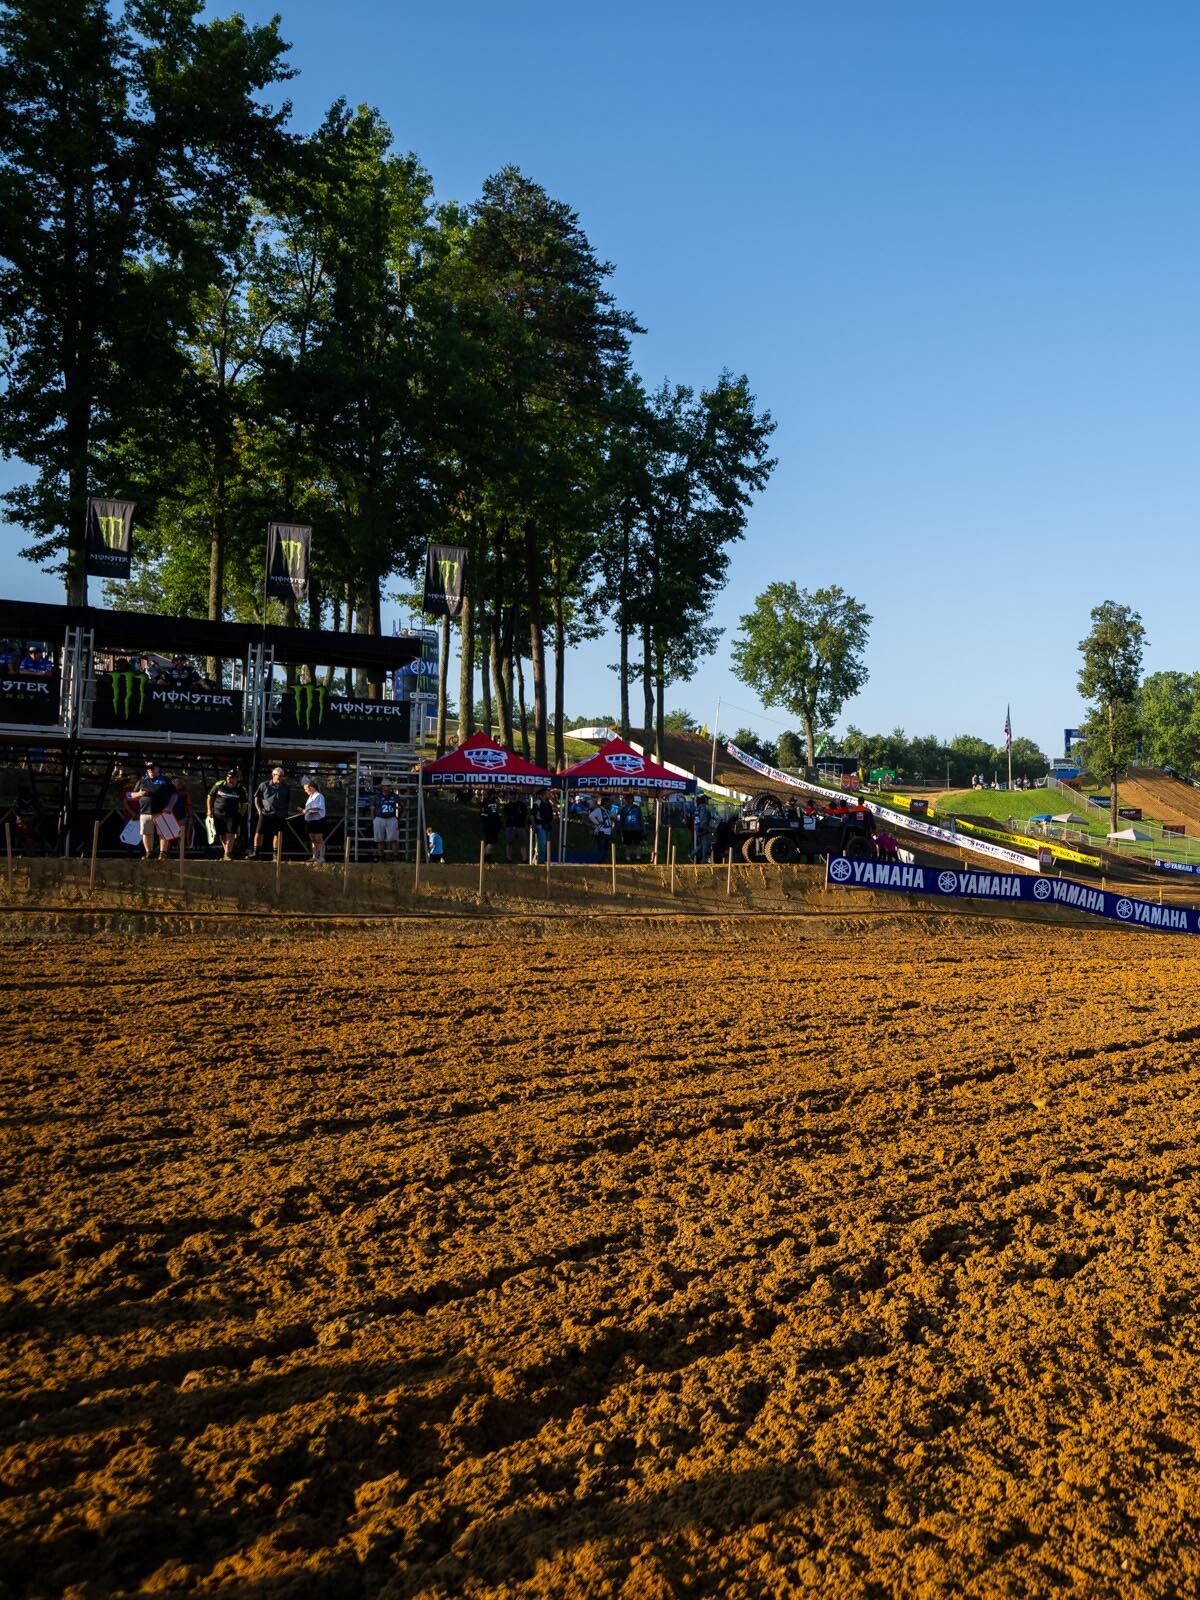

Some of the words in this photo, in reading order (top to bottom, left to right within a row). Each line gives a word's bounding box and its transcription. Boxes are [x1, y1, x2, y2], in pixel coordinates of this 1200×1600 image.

[152, 689, 233, 706] MONSTER
[330, 701, 401, 716] MONSTER
[853, 861, 924, 888] YAMAHA
[1171, 863, 1193, 873] YAMAHA
[959, 873, 1021, 897] YAMAHA
[1052, 880, 1105, 912] YAMAHA
[1134, 902, 1187, 929] YAMAHA
